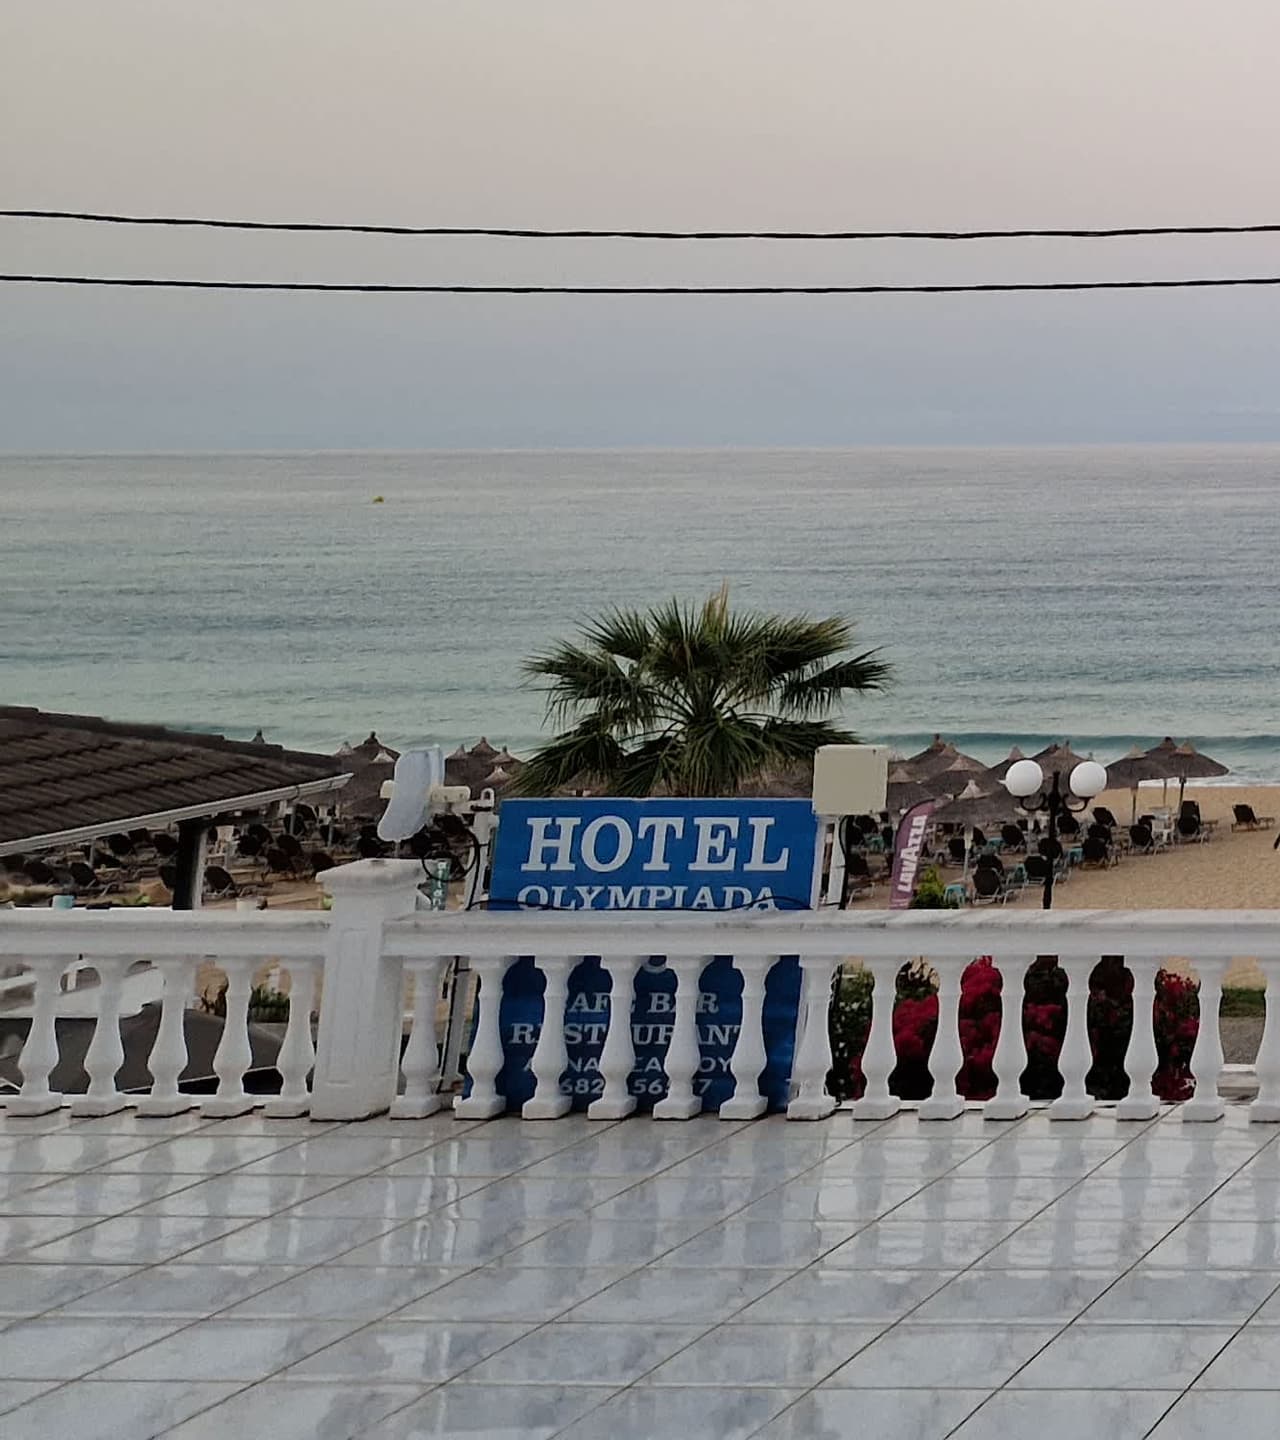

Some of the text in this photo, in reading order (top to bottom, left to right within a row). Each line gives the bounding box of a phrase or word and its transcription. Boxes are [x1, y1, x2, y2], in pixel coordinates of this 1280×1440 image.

[520, 815, 790, 873] HOTEL
[517, 885, 780, 910] OLYMPIADA
[646, 992, 720, 1014] BR
